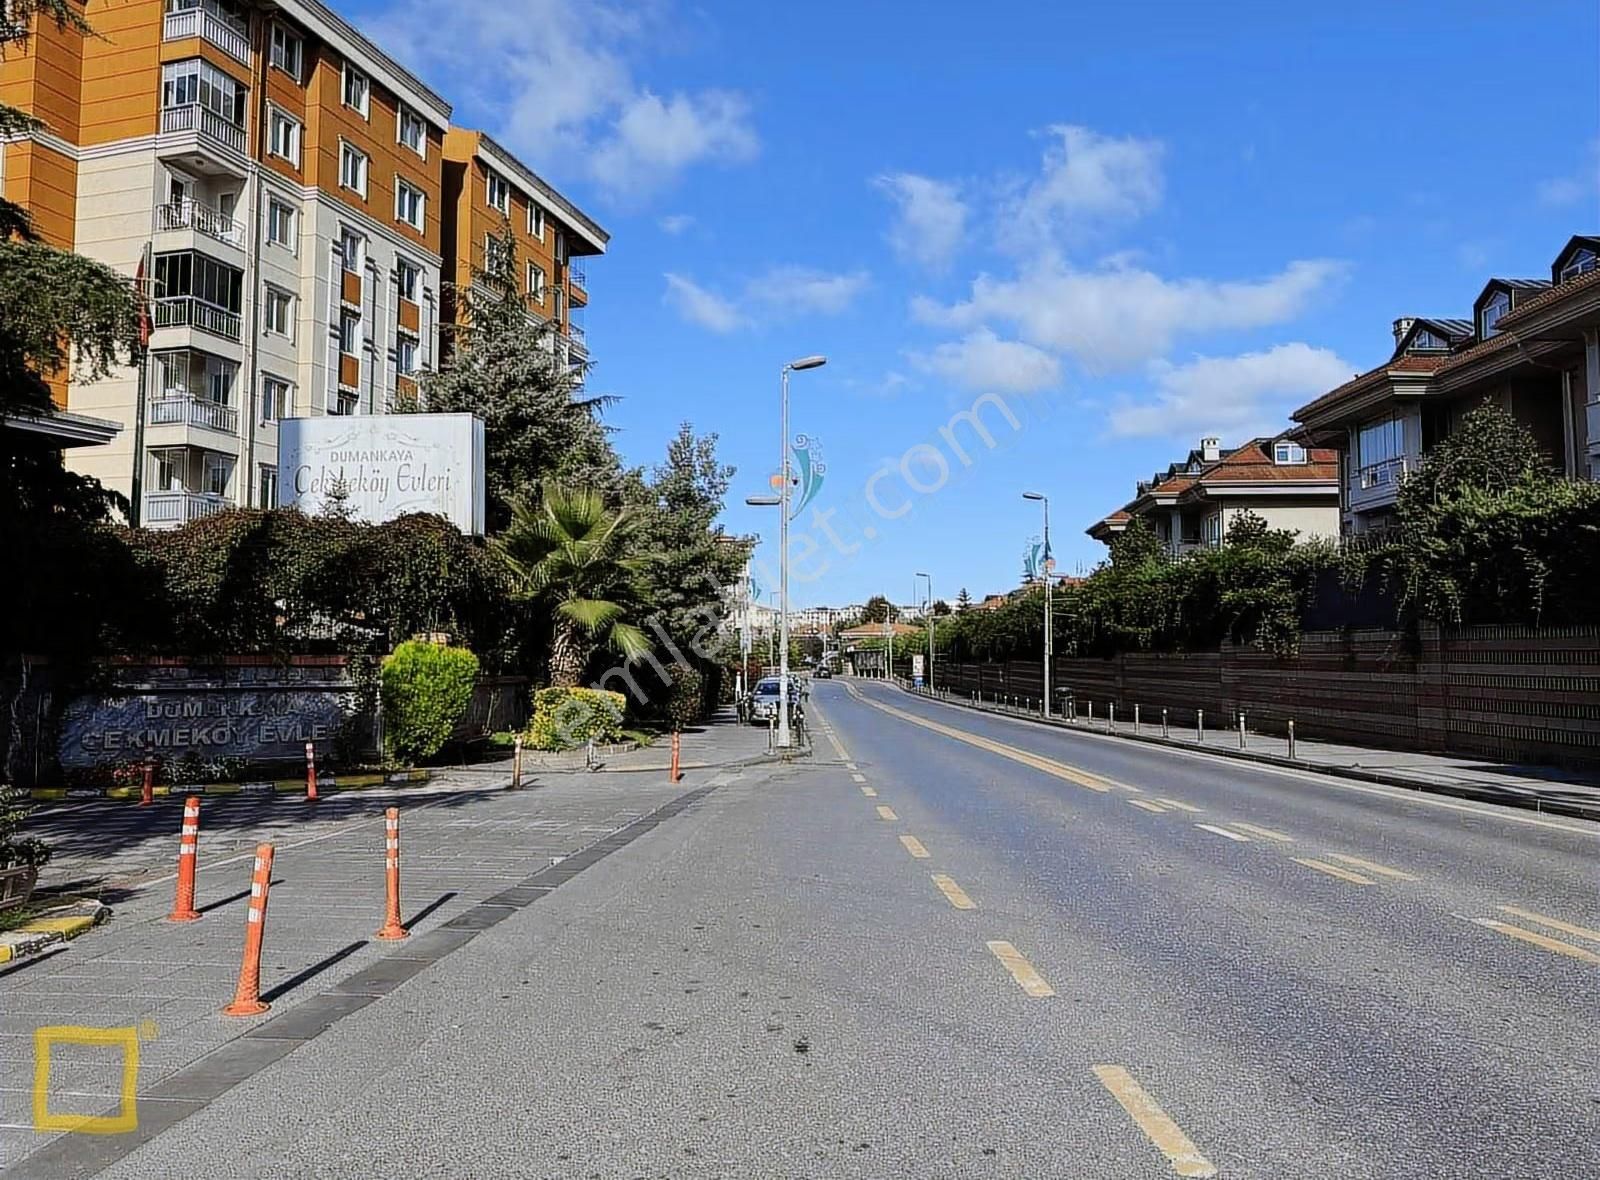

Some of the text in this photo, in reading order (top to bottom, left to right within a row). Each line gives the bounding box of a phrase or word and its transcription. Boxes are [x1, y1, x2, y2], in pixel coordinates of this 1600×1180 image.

[330, 450, 414, 463] DUMANKAYA
[294, 463, 451, 504] Çekeköy Evleri
